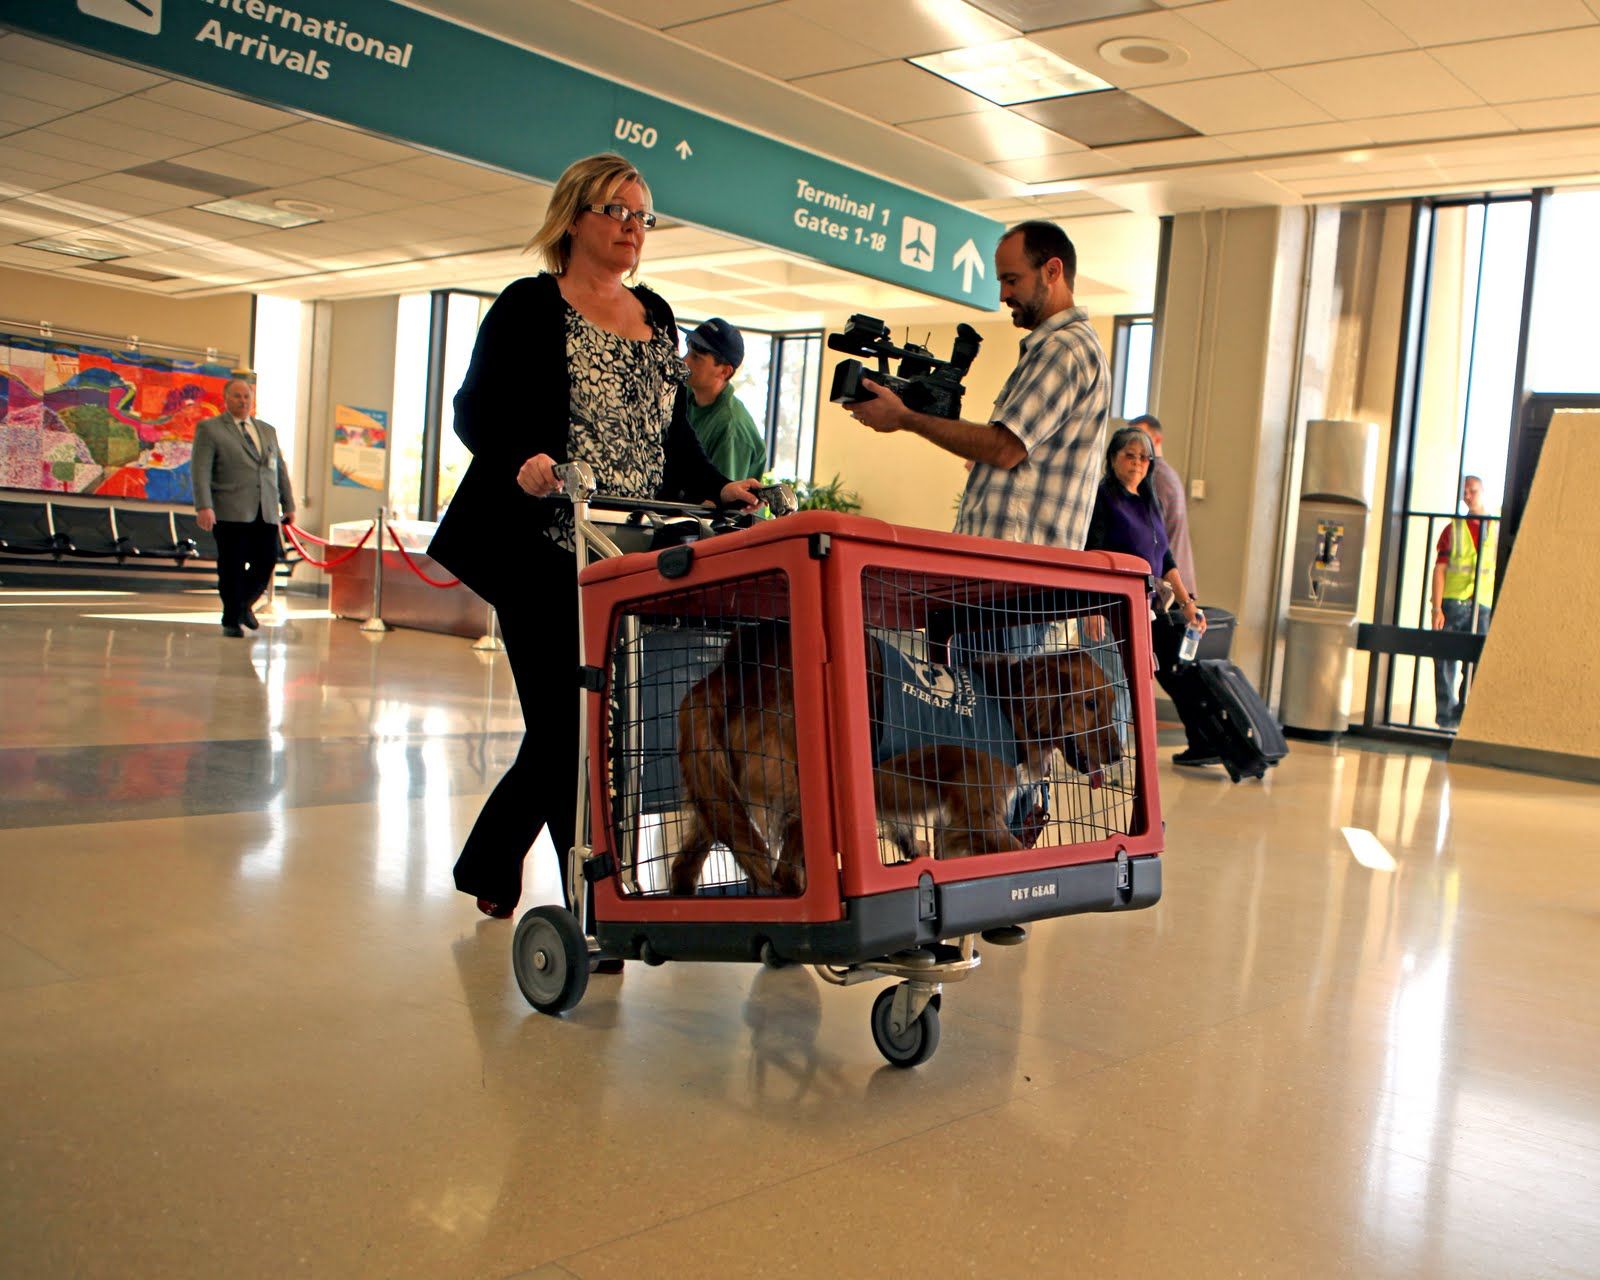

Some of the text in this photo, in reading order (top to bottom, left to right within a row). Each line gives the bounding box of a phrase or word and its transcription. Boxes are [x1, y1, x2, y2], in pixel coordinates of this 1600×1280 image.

[195, 19, 331, 80] Arrivals
[200, 0, 414, 68] ternational
[615, 117, 658, 149] USO
[796, 178, 890, 226] Terminal 1
[793, 207, 887, 252] Gates 1-18
[1011, 883, 1056, 901] PET GEAR
